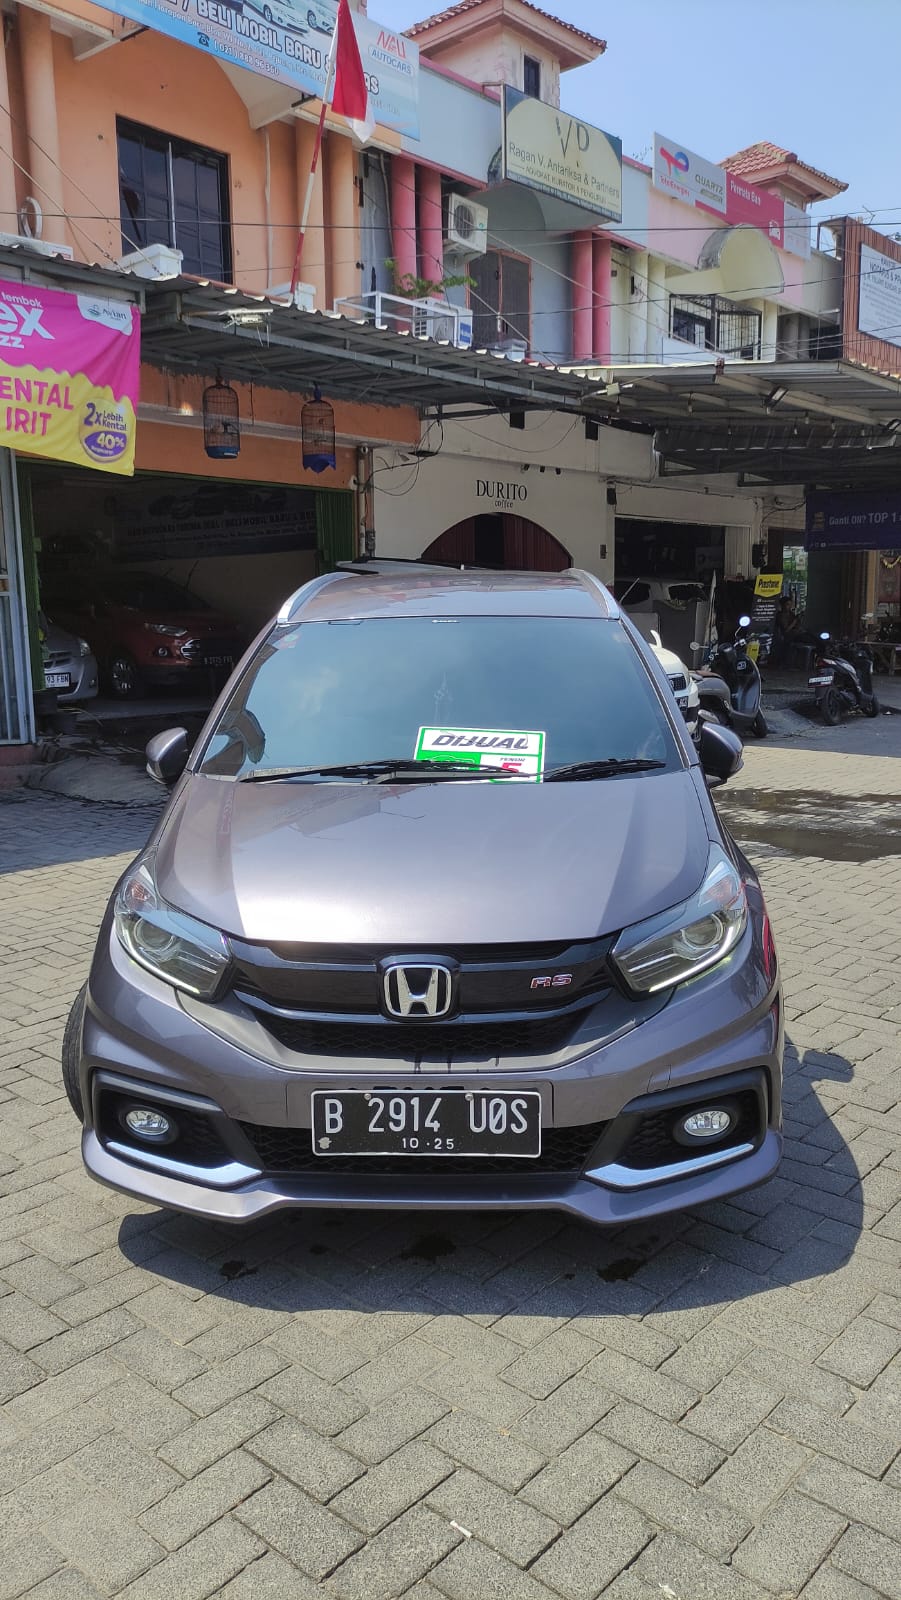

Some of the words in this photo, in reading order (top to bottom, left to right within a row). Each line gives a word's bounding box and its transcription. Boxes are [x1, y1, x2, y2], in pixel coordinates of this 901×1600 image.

[196, 0, 233, 31] BELI
[235, 14, 283, 53] MOBIL
[284, 35, 322, 70] BARU
[371, 48, 412, 75] AUTOCARS
[509, 142, 536, 163] Ragan
[547, 159, 582, 183] Antariksa
[583, 175, 590, 186] &
[694, 174, 723, 195] QUARTZ
[6, 405, 52, 437] IRIT
[102, 409, 124, 422] Lebih
[102, 418, 127, 432] Kental
[97, 432, 125, 450] 40%
[476, 479, 528, 501] DURITO
[494, 500, 514, 508] coffee
[829, 516, 850, 526] Ganti
[868, 512, 889, 524] TOP
[432, 734, 529, 750] DIJUAL
[530, 973, 573, 989] RS
[325, 1098, 344, 1134] B
[367, 1097, 443, 1133] 2914
